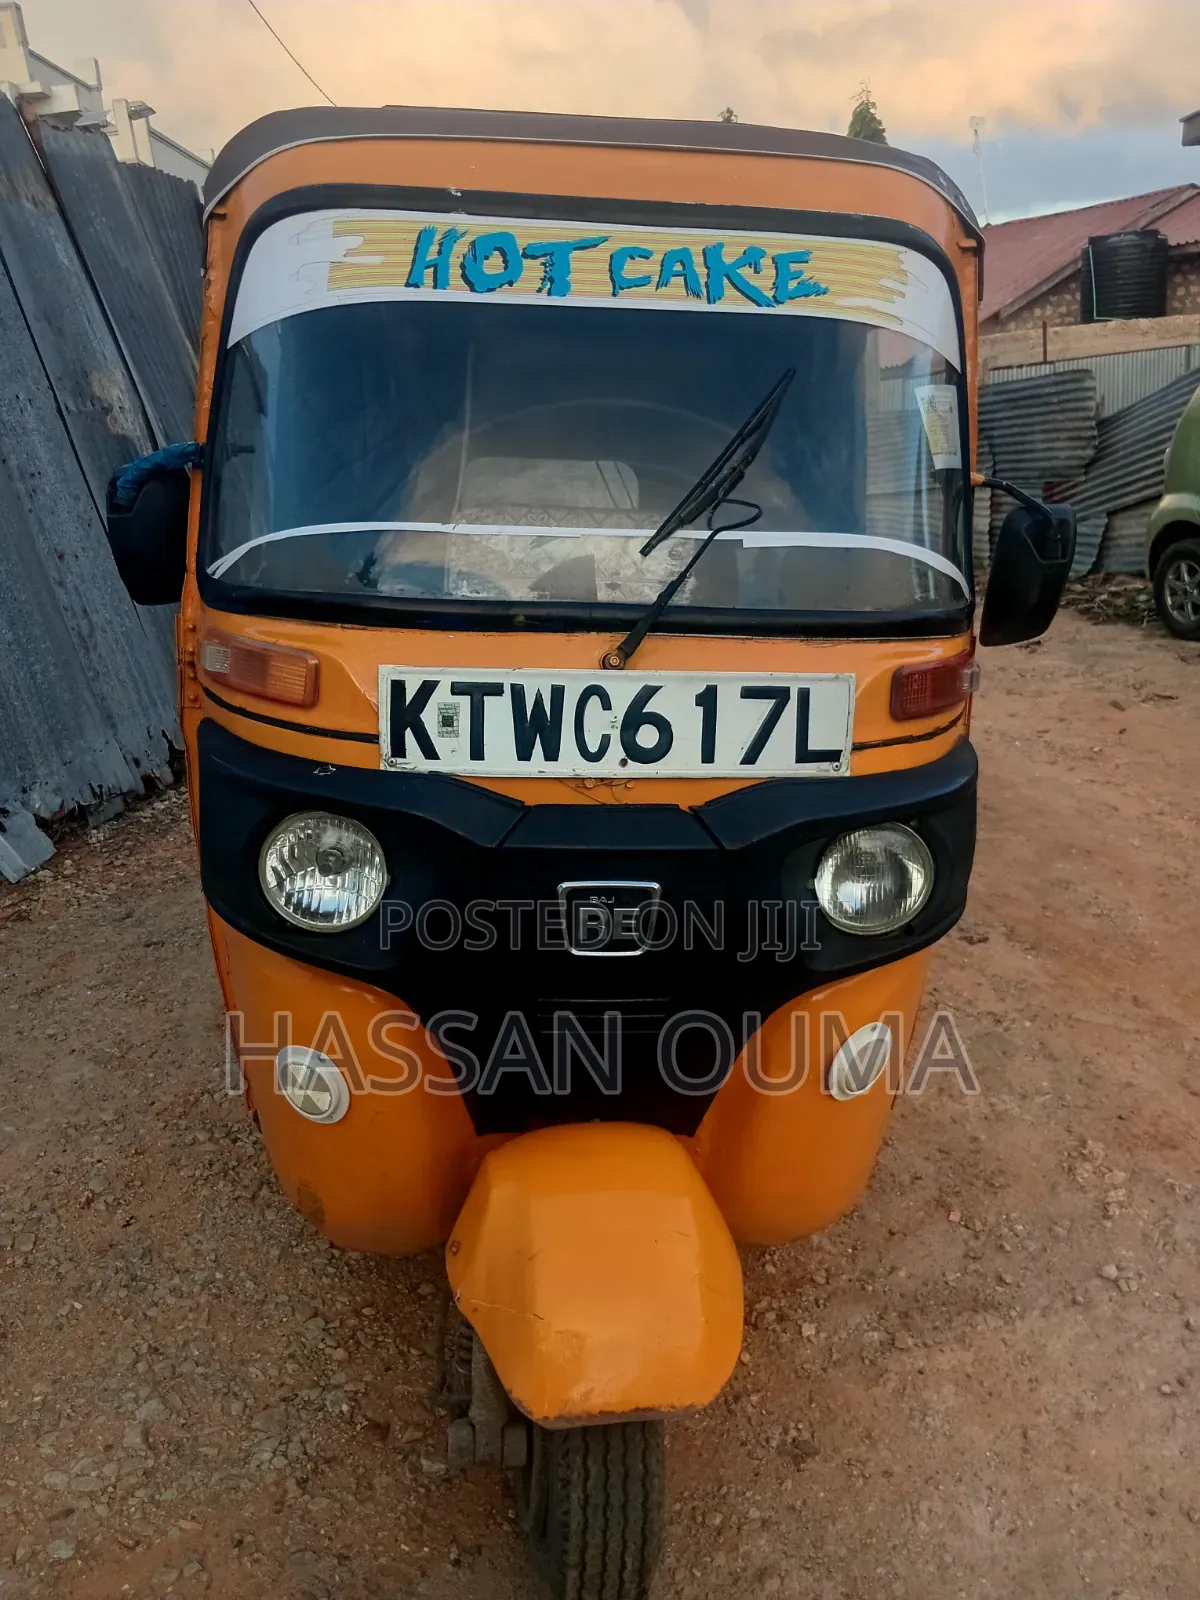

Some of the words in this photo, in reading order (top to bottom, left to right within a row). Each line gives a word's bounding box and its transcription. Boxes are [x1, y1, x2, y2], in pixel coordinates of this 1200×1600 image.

[404, 224, 611, 298] HOT
[609, 241, 830, 308] CAKE
[578, 907, 641, 940] RE
